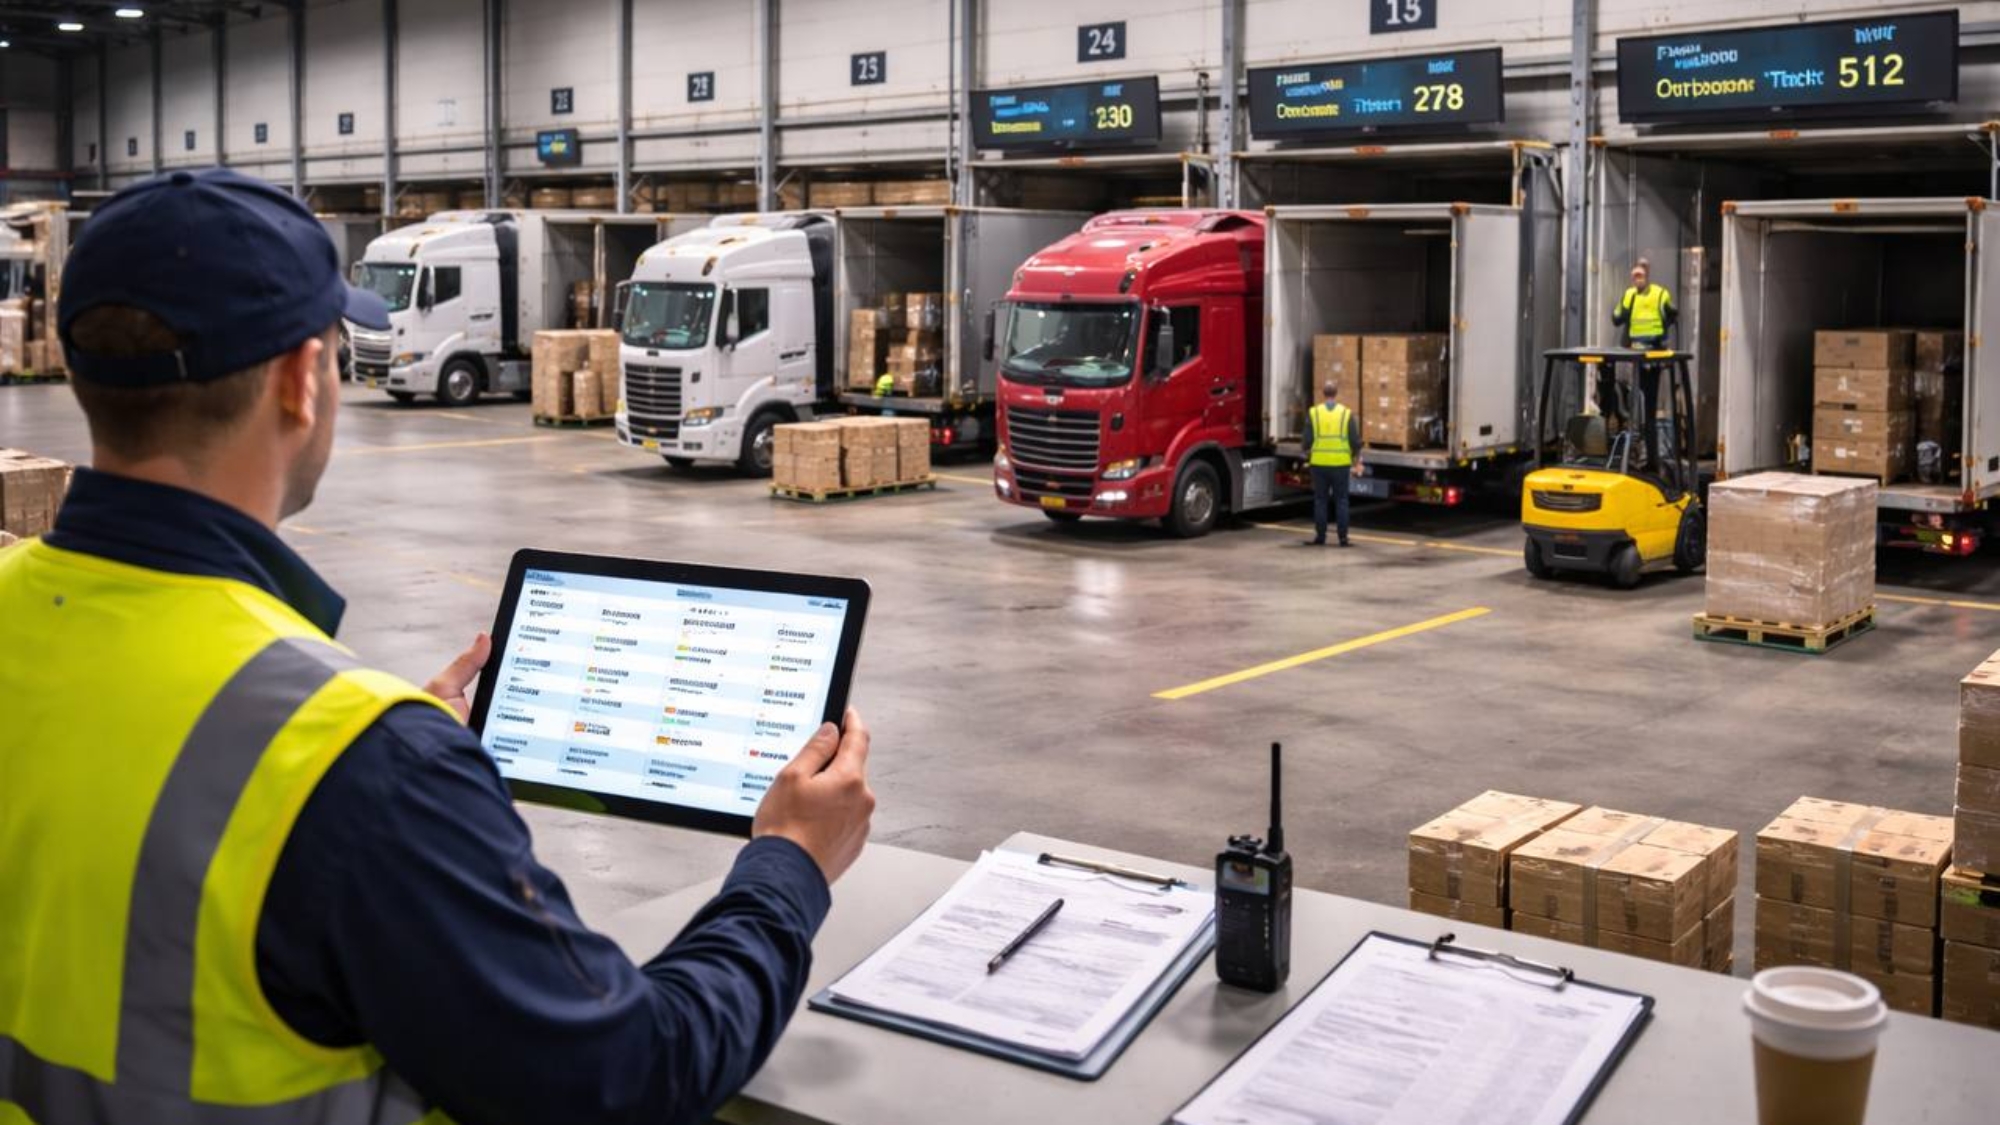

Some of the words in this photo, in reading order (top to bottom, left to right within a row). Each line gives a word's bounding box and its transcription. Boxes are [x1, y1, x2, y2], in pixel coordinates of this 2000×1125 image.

[1839, 52, 1904, 88] 512
[1413, 83, 1464, 112] 278
[1095, 104, 1132, 129] 230
